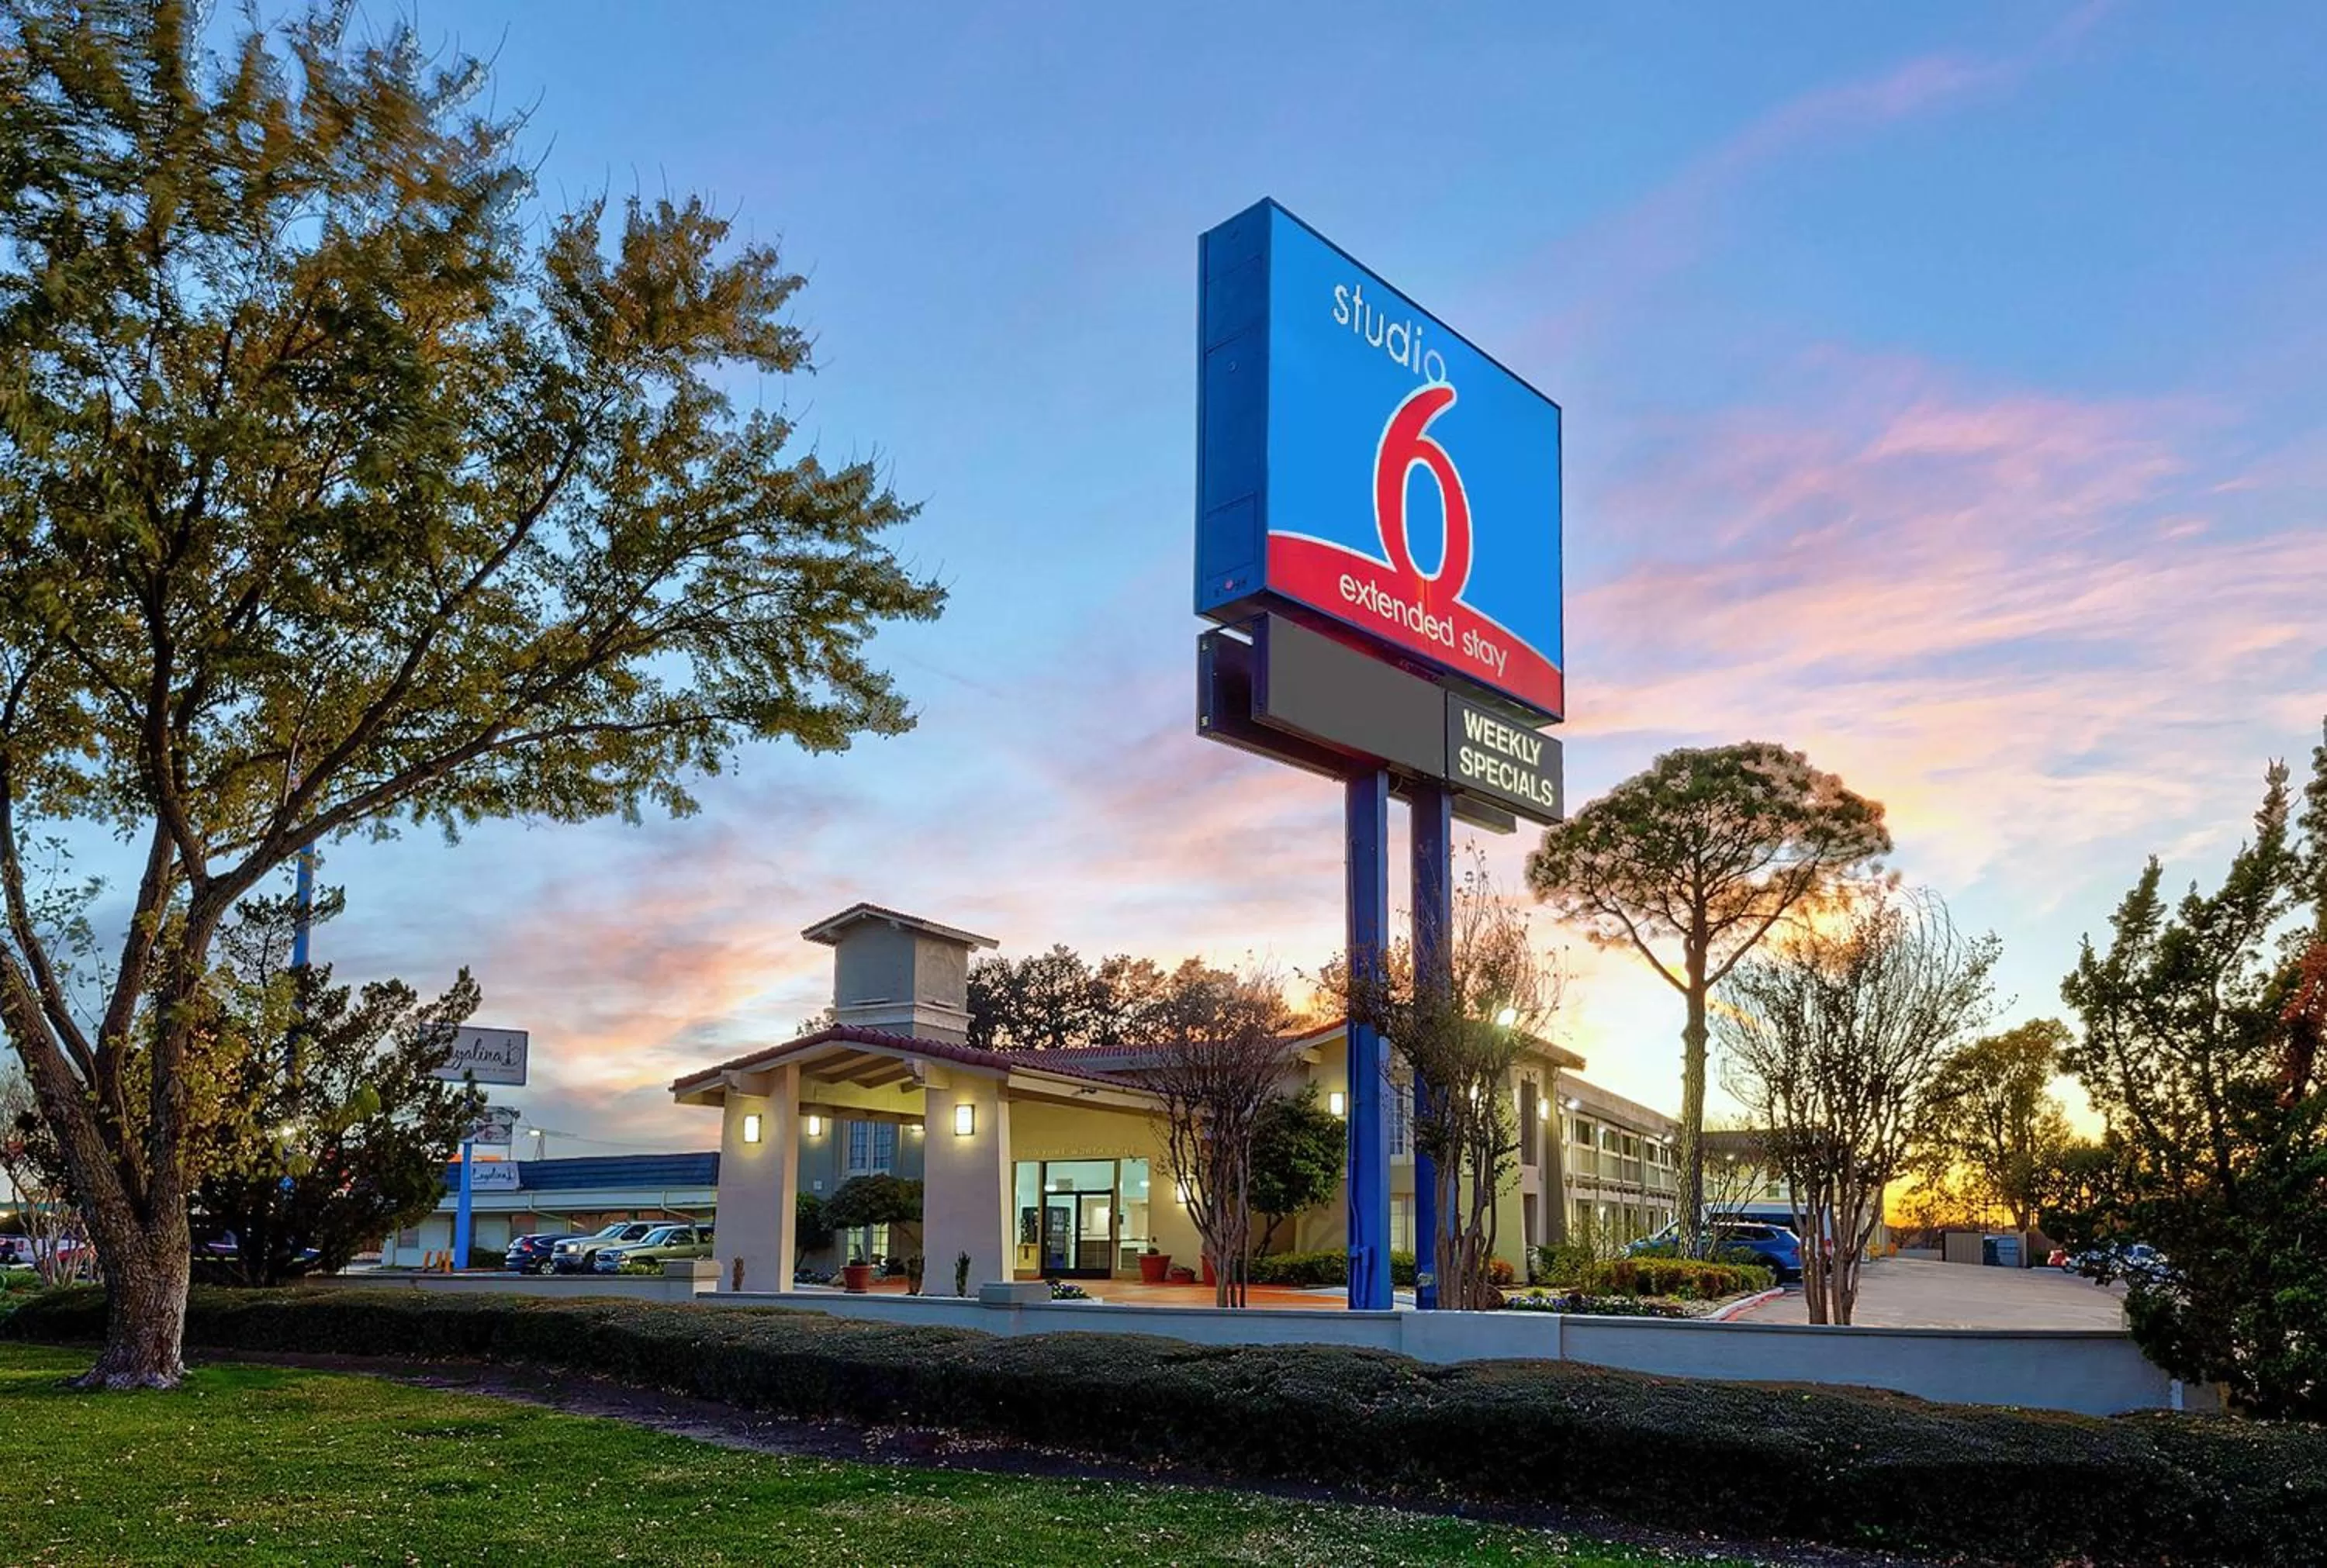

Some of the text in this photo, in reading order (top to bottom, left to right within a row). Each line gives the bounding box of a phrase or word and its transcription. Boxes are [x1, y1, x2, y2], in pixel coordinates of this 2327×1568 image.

[1333, 283, 1447, 385] studio
[1373, 382, 1473, 601] 6
[1340, 573, 1507, 677] extended stay
[1459, 746, 1554, 807] SPECIALS
[1463, 709, 1542, 766] WEEKLY
